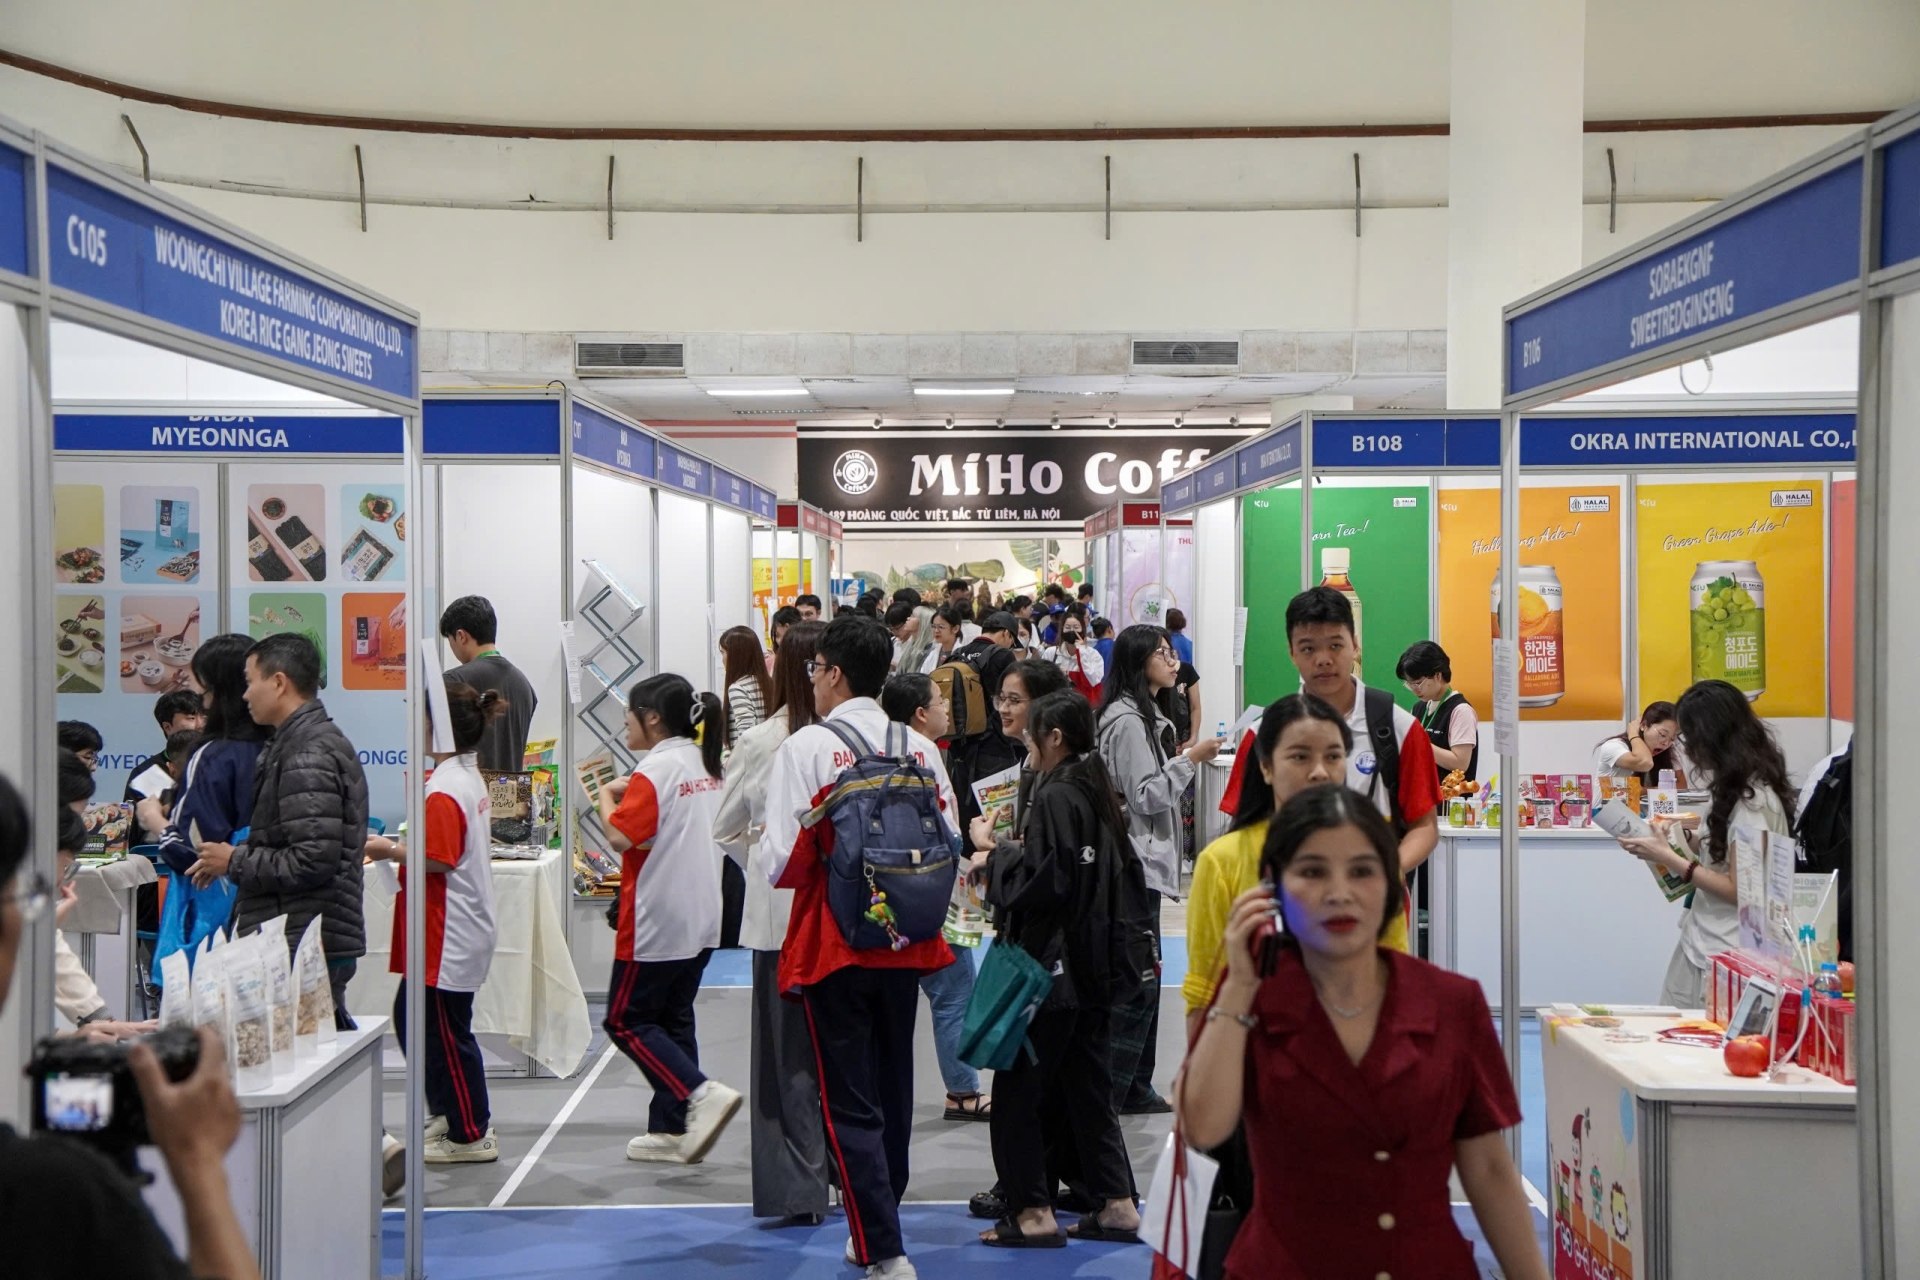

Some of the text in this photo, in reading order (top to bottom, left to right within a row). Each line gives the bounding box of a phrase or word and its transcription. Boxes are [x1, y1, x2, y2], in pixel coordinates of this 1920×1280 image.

[67, 214, 107, 266] C105
[1649, 240, 1714, 300] SOBAEKGNF
[154, 225, 226, 288] WOONGCHI
[226, 256, 272, 306] VILLAGE
[273, 274, 316, 321] FARMING
[317, 295, 374, 344] CORPORATION
[1630, 280, 1734, 349] SWEETREDGINSENG
[220, 299, 373, 380] KOREA RICE GANG JEONG SWEETS
[1523, 337, 1541, 367] B106
[152, 427, 289, 448] MYEONNGA
[1352, 435, 1403, 452] B108
[1570, 433, 1629, 450] OKRA
[1634, 431, 1804, 449] INTERNATIONAL
[846, 452, 865, 461] MiHo
[1084, 448, 1211, 494] Coff
[843, 483, 868, 492] Coffee
[847, 509, 886, 520] HOÀNG
[890, 507, 920, 521] QUỐC
[925, 508, 949, 522] VIỆT,
[952, 506, 971, 520] BẮC
[977, 507, 992, 520] TỪ
[995, 507, 1021, 521] LIÊM,
[1024, 507, 1038, 520] HÀ
[1042, 507, 1061, 521] NỘI
[1312, 531, 1332, 541] orn
[1663, 534, 1702, 552] Green
[1704, 527, 1745, 545] Grape
[1524, 640, 1557, 657] 한라봉
[1725, 636, 1758, 653] 청포도
[1526, 656, 1558, 673] 에이드
[1726, 652, 1759, 669] 에이드
